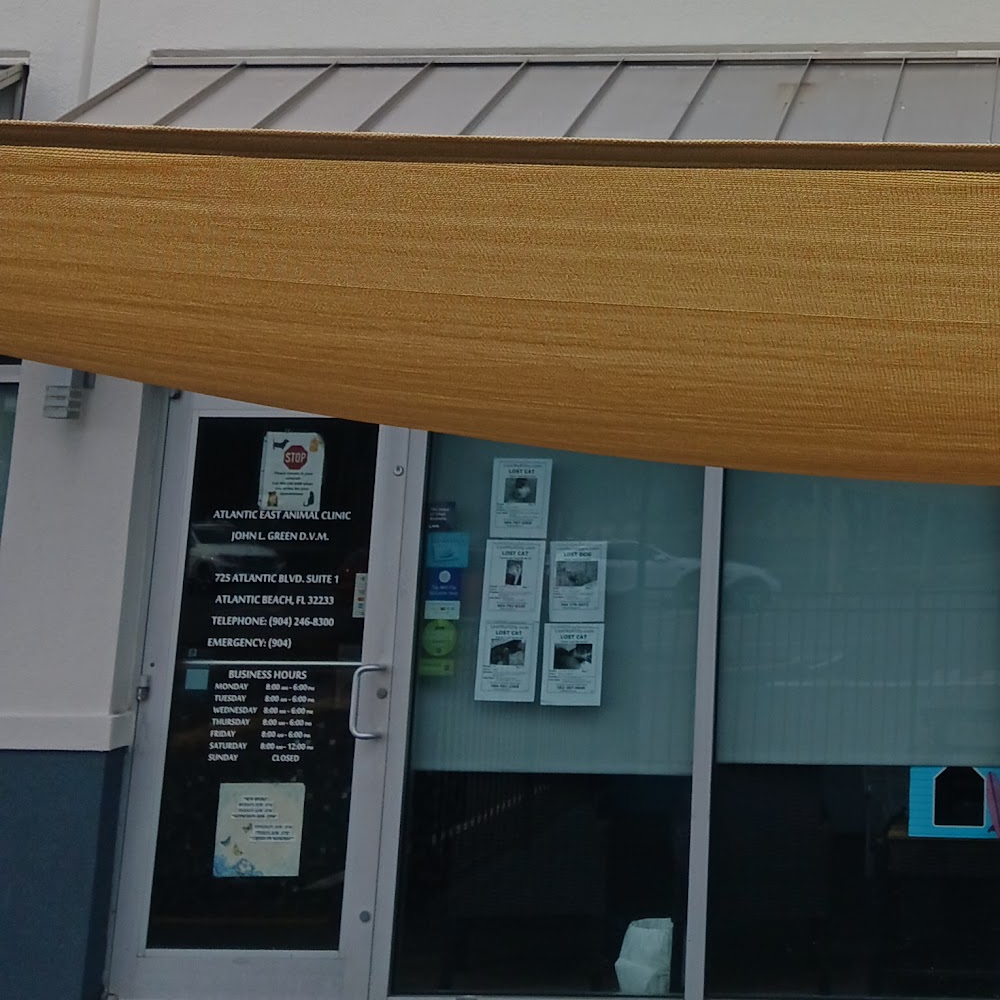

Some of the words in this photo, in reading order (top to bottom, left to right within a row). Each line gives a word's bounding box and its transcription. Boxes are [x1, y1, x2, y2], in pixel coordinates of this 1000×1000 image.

[285, 452, 306, 463] STOP
[213, 510, 258, 519] ATLANTIC
[259, 510, 281, 519] EAST
[282, 510, 319, 520] ANIMAL
[321, 511, 351, 520] CLINIC
[231, 531, 257, 542] JOHN
[258, 532, 266, 540] L.
[268, 532, 298, 540] GREEN
[299, 532, 329, 541] D.V.M.
[215, 573, 230, 582] 725
[232, 574, 277, 583] ATLANTIC
[278, 574, 305, 584] BLVD.
[307, 575, 332, 584] SUITE
[334, 575, 339, 584] 1
[215, 595, 261, 604] ATLANTIC
[262, 595, 294, 605] BEACH,
[296, 596, 306, 605] FL
[307, 596, 334, 605] 32233
[212, 616, 267, 625] TELEPHONE:
[269, 616, 292, 627] (904)
[294, 617, 334, 627] 246-8300
[207, 638, 266, 647] EMERGENCY:
[268, 638, 292, 649] (904)
[228, 670, 272, 679] BUSINESS
[273, 670, 307, 680] HOURS
[213, 706, 258, 714] WEDNESDAY
[212, 718, 250, 726] THURSDAY
[210, 730, 236, 738] FRIDAY
[209, 742, 247, 750] SATURDAY
[260, 742, 275, 750] 8:00
[272, 754, 300, 762] CLOSED
